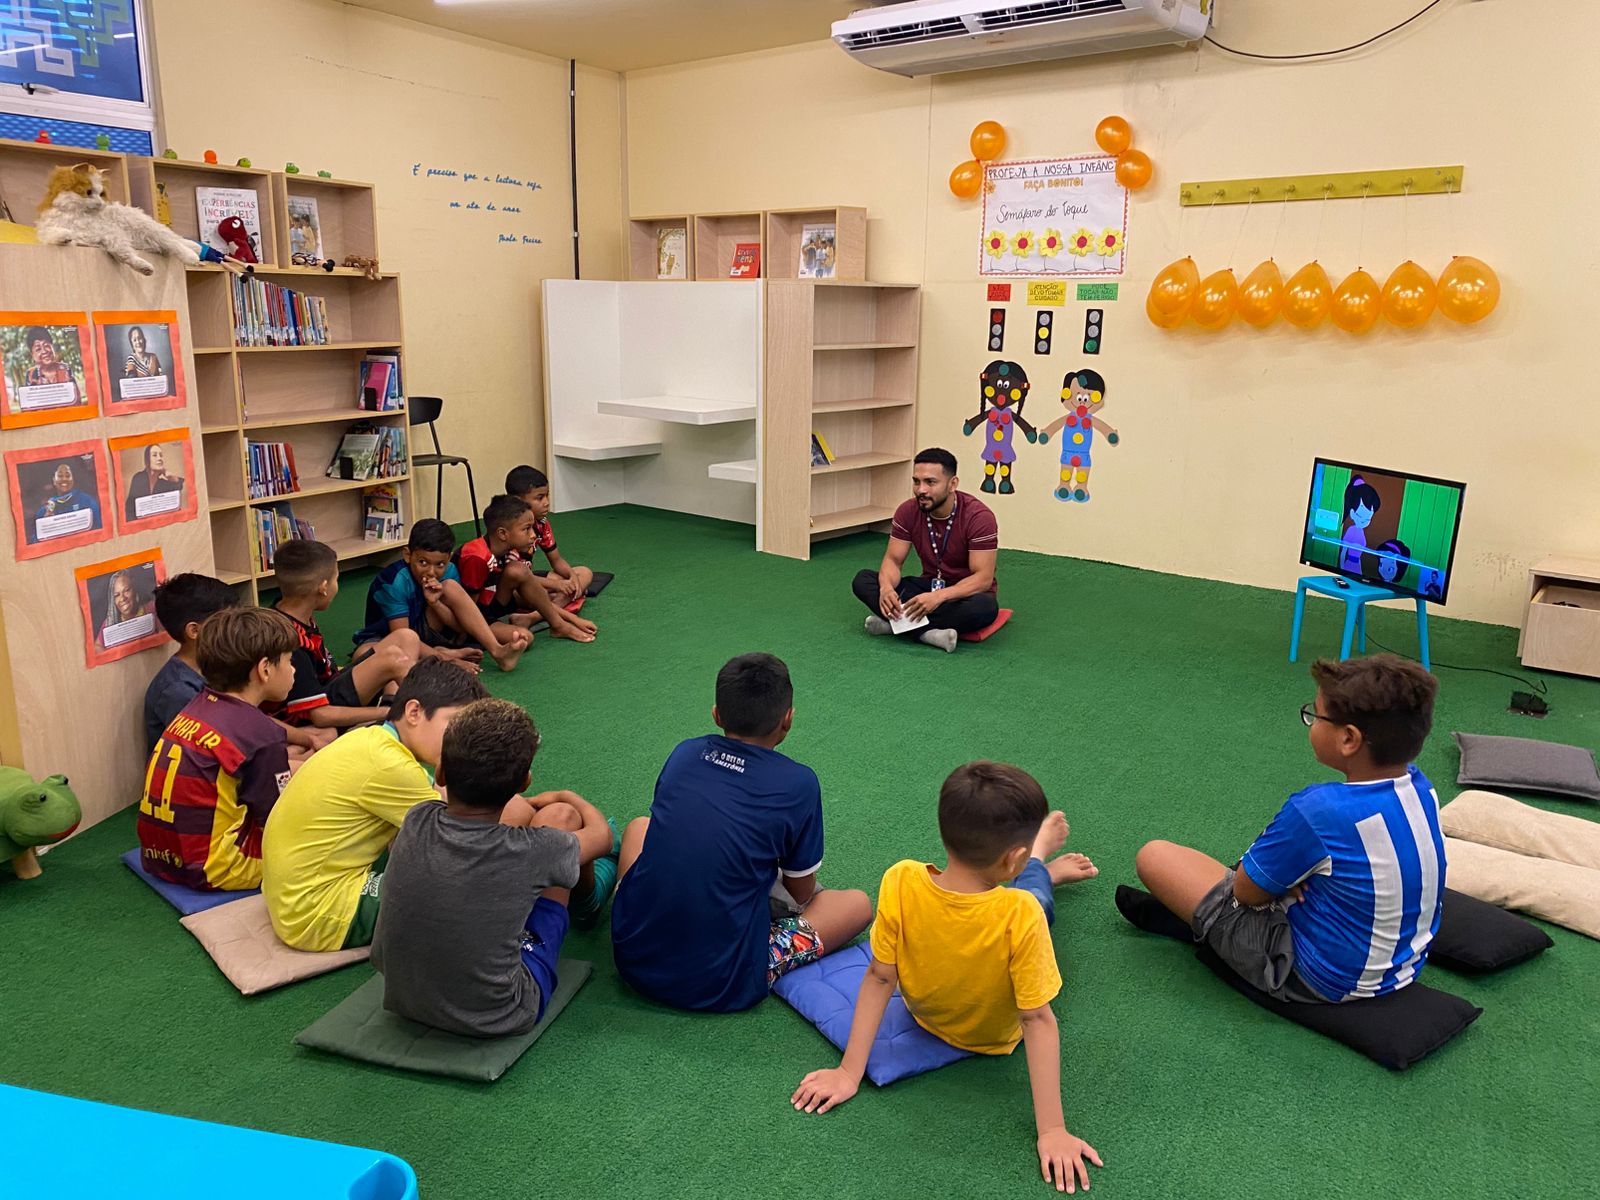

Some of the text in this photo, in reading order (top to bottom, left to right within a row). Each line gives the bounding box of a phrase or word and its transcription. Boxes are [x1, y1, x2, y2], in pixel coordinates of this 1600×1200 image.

[413, 163, 421, 176] É
[427, 168, 458, 177] preciso
[464, 173, 478, 181] que
[496, 174, 522, 186] leitura
[527, 181, 542, 191] seja
[988, 160, 1117, 180] PROTEJA A NOSSA INFÂNC
[1023, 177, 1083, 192] FAÇA BONITO!
[466, 201, 480, 209] ato
[487, 202, 496, 211] de
[498, 234, 542, 244] Paulo Freire
[140, 738, 182, 823] 11
